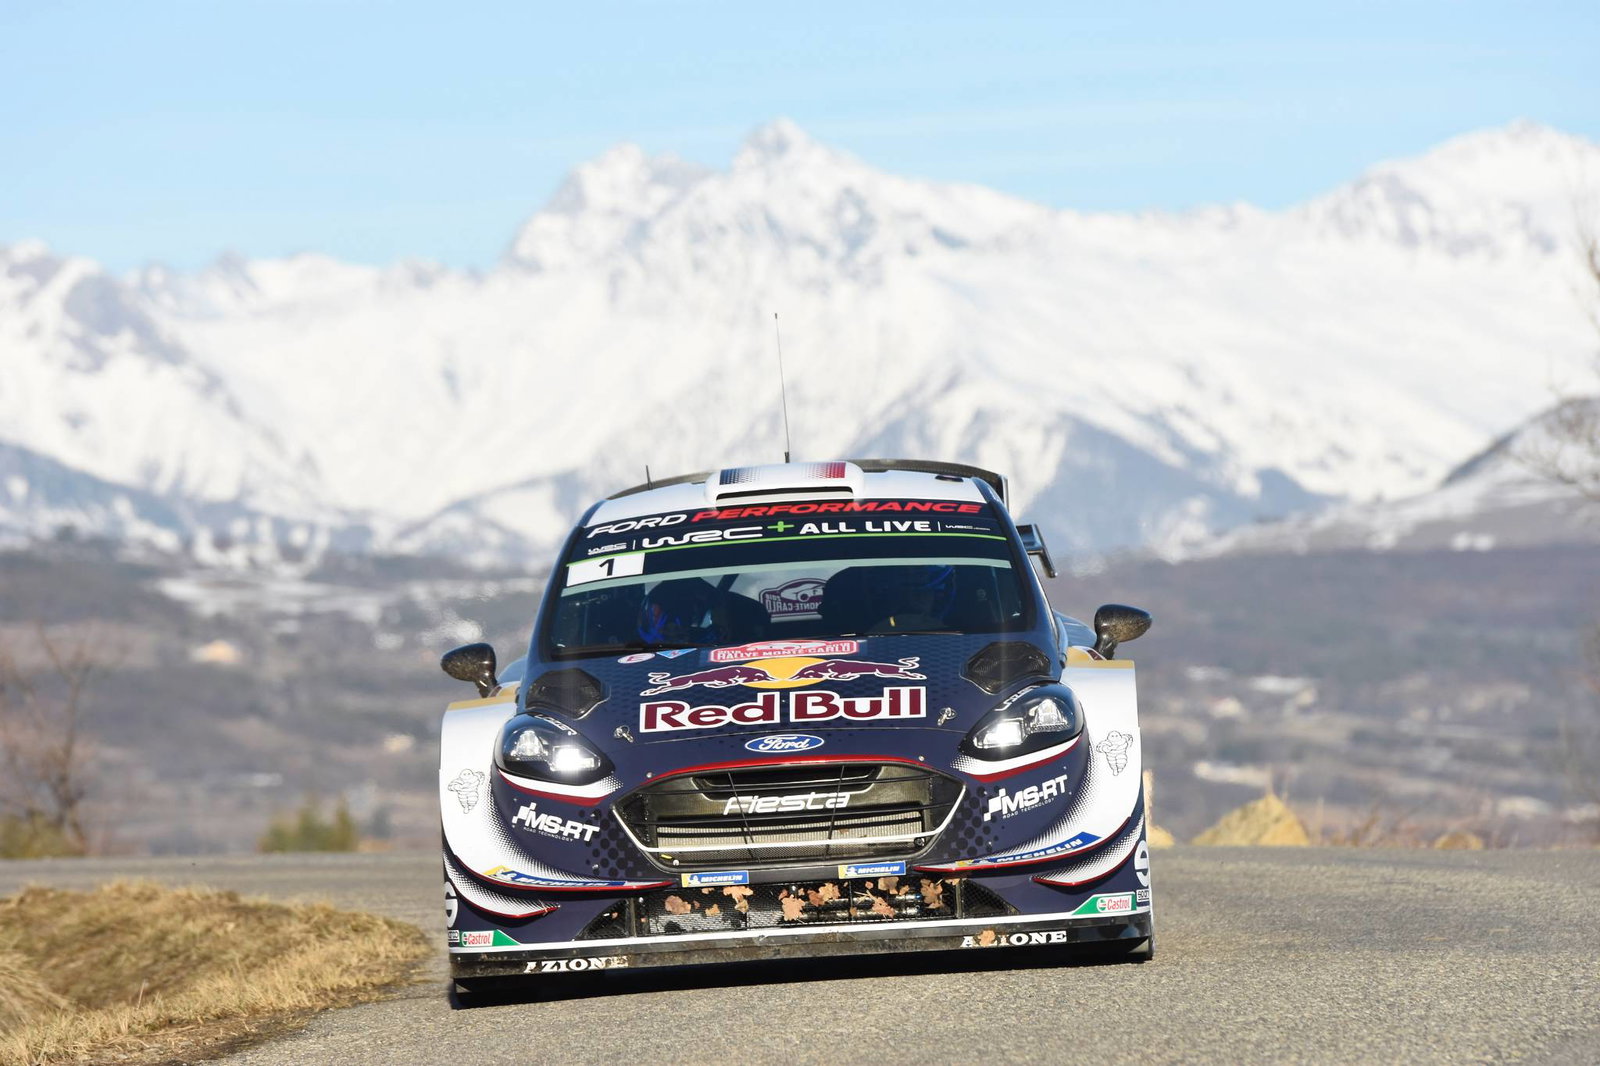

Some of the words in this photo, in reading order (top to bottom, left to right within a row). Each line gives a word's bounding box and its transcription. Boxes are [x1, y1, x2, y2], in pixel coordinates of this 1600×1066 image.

[587, 514, 687, 538] FORD
[691, 501, 982, 522] PERFORMANCE
[800, 520, 856, 534] ALL
[865, 520, 932, 532] LIVE
[599, 558, 615, 577] 1
[642, 692, 777, 731] Red
[793, 688, 923, 721] Bull
[758, 735, 809, 751] Ford
[723, 792, 850, 815] Fiesta
[1001, 774, 1068, 815] MS-RT
[525, 810, 600, 842] MS-RT
[997, 839, 1083, 862] MICHELIN
[701, 874, 743, 883] MICHELIN
[857, 865, 900, 875] MICHELIN
[1107, 898, 1130, 911] Castrol
[468, 933, 491, 945] Castrol
[960, 931, 1067, 948] AIONE
